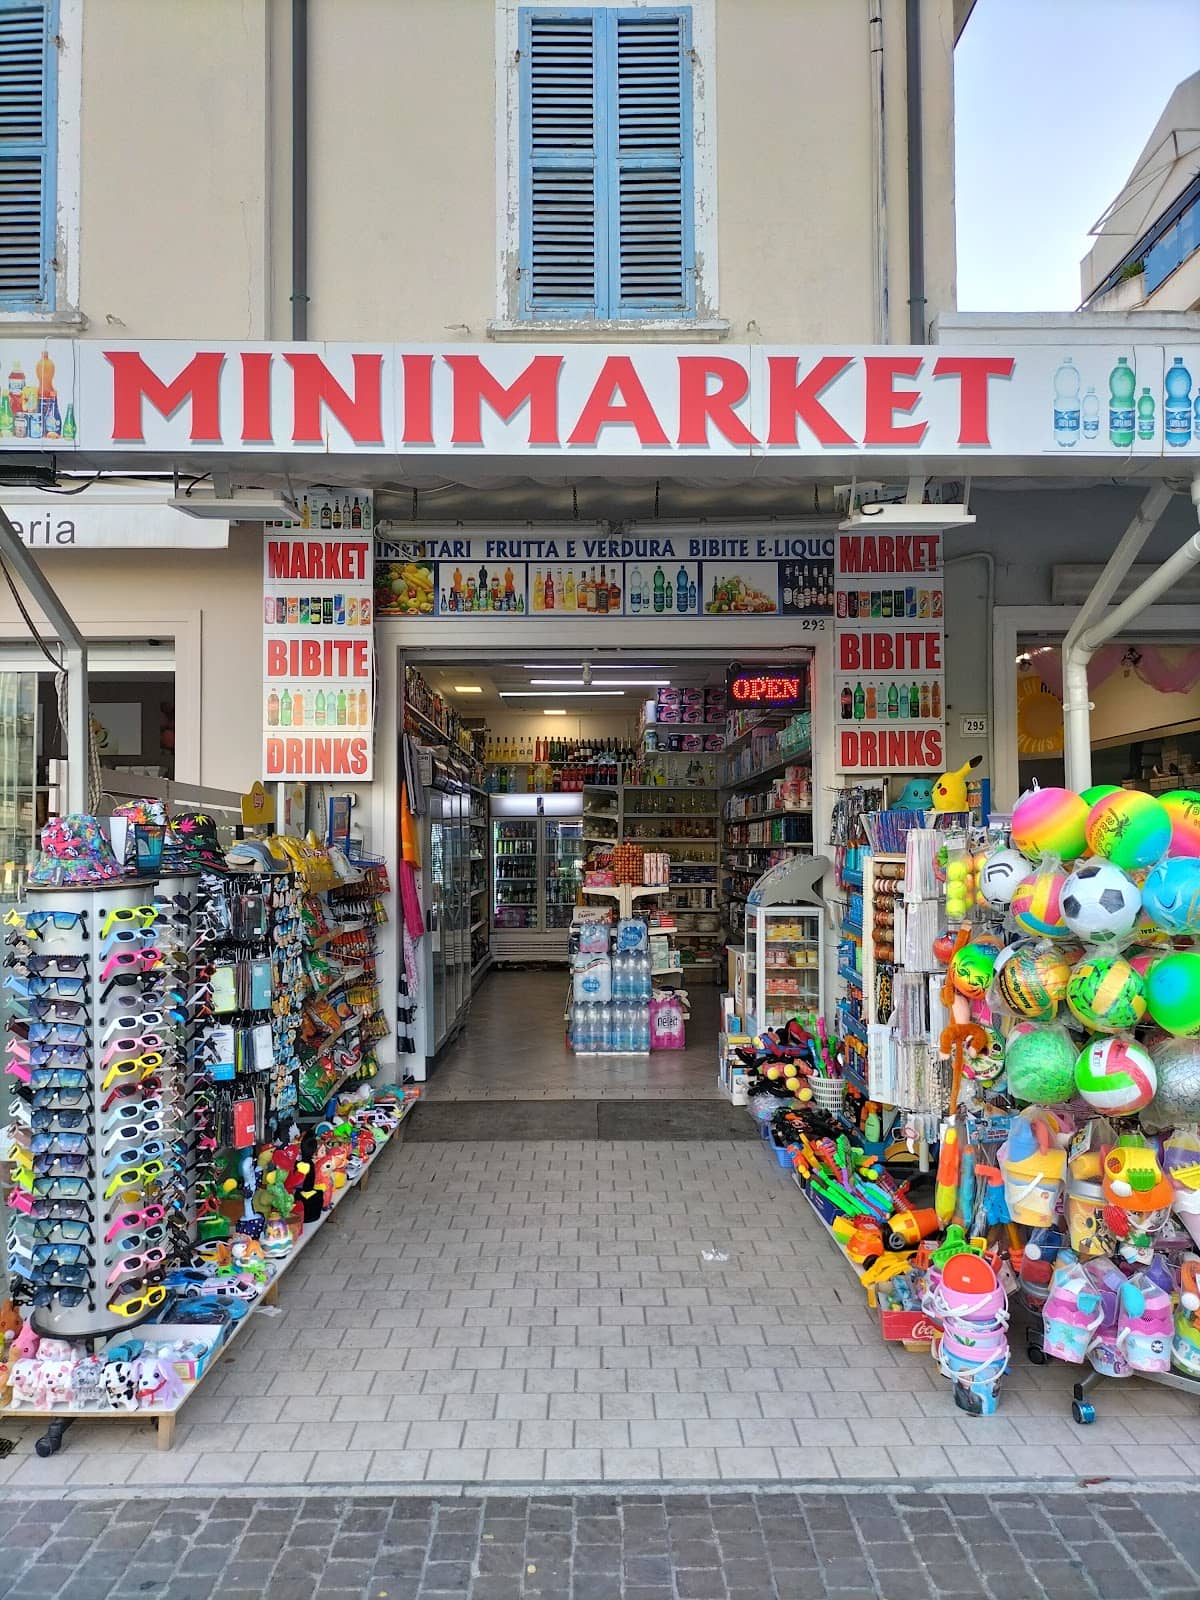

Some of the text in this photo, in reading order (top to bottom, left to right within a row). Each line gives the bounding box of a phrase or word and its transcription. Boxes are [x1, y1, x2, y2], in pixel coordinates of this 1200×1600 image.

[103, 351, 1016, 446] MINIMARKET
[268, 541, 368, 580] MARKET
[486, 540, 559, 558] FRUTTA
[566, 540, 577, 558] E
[582, 540, 676, 558] VERDURA
[688, 539, 749, 557] BIBITE
[840, 535, 939, 573] MARKET
[802, 619, 825, 631] 293
[268, 639, 368, 677] BIBITE
[840, 632, 941, 671] BIBITE
[733, 678, 800, 699] OPEN
[967, 721, 985, 731] 295
[267, 737, 368, 775] DRINKS
[840, 730, 942, 768] DRINKS
